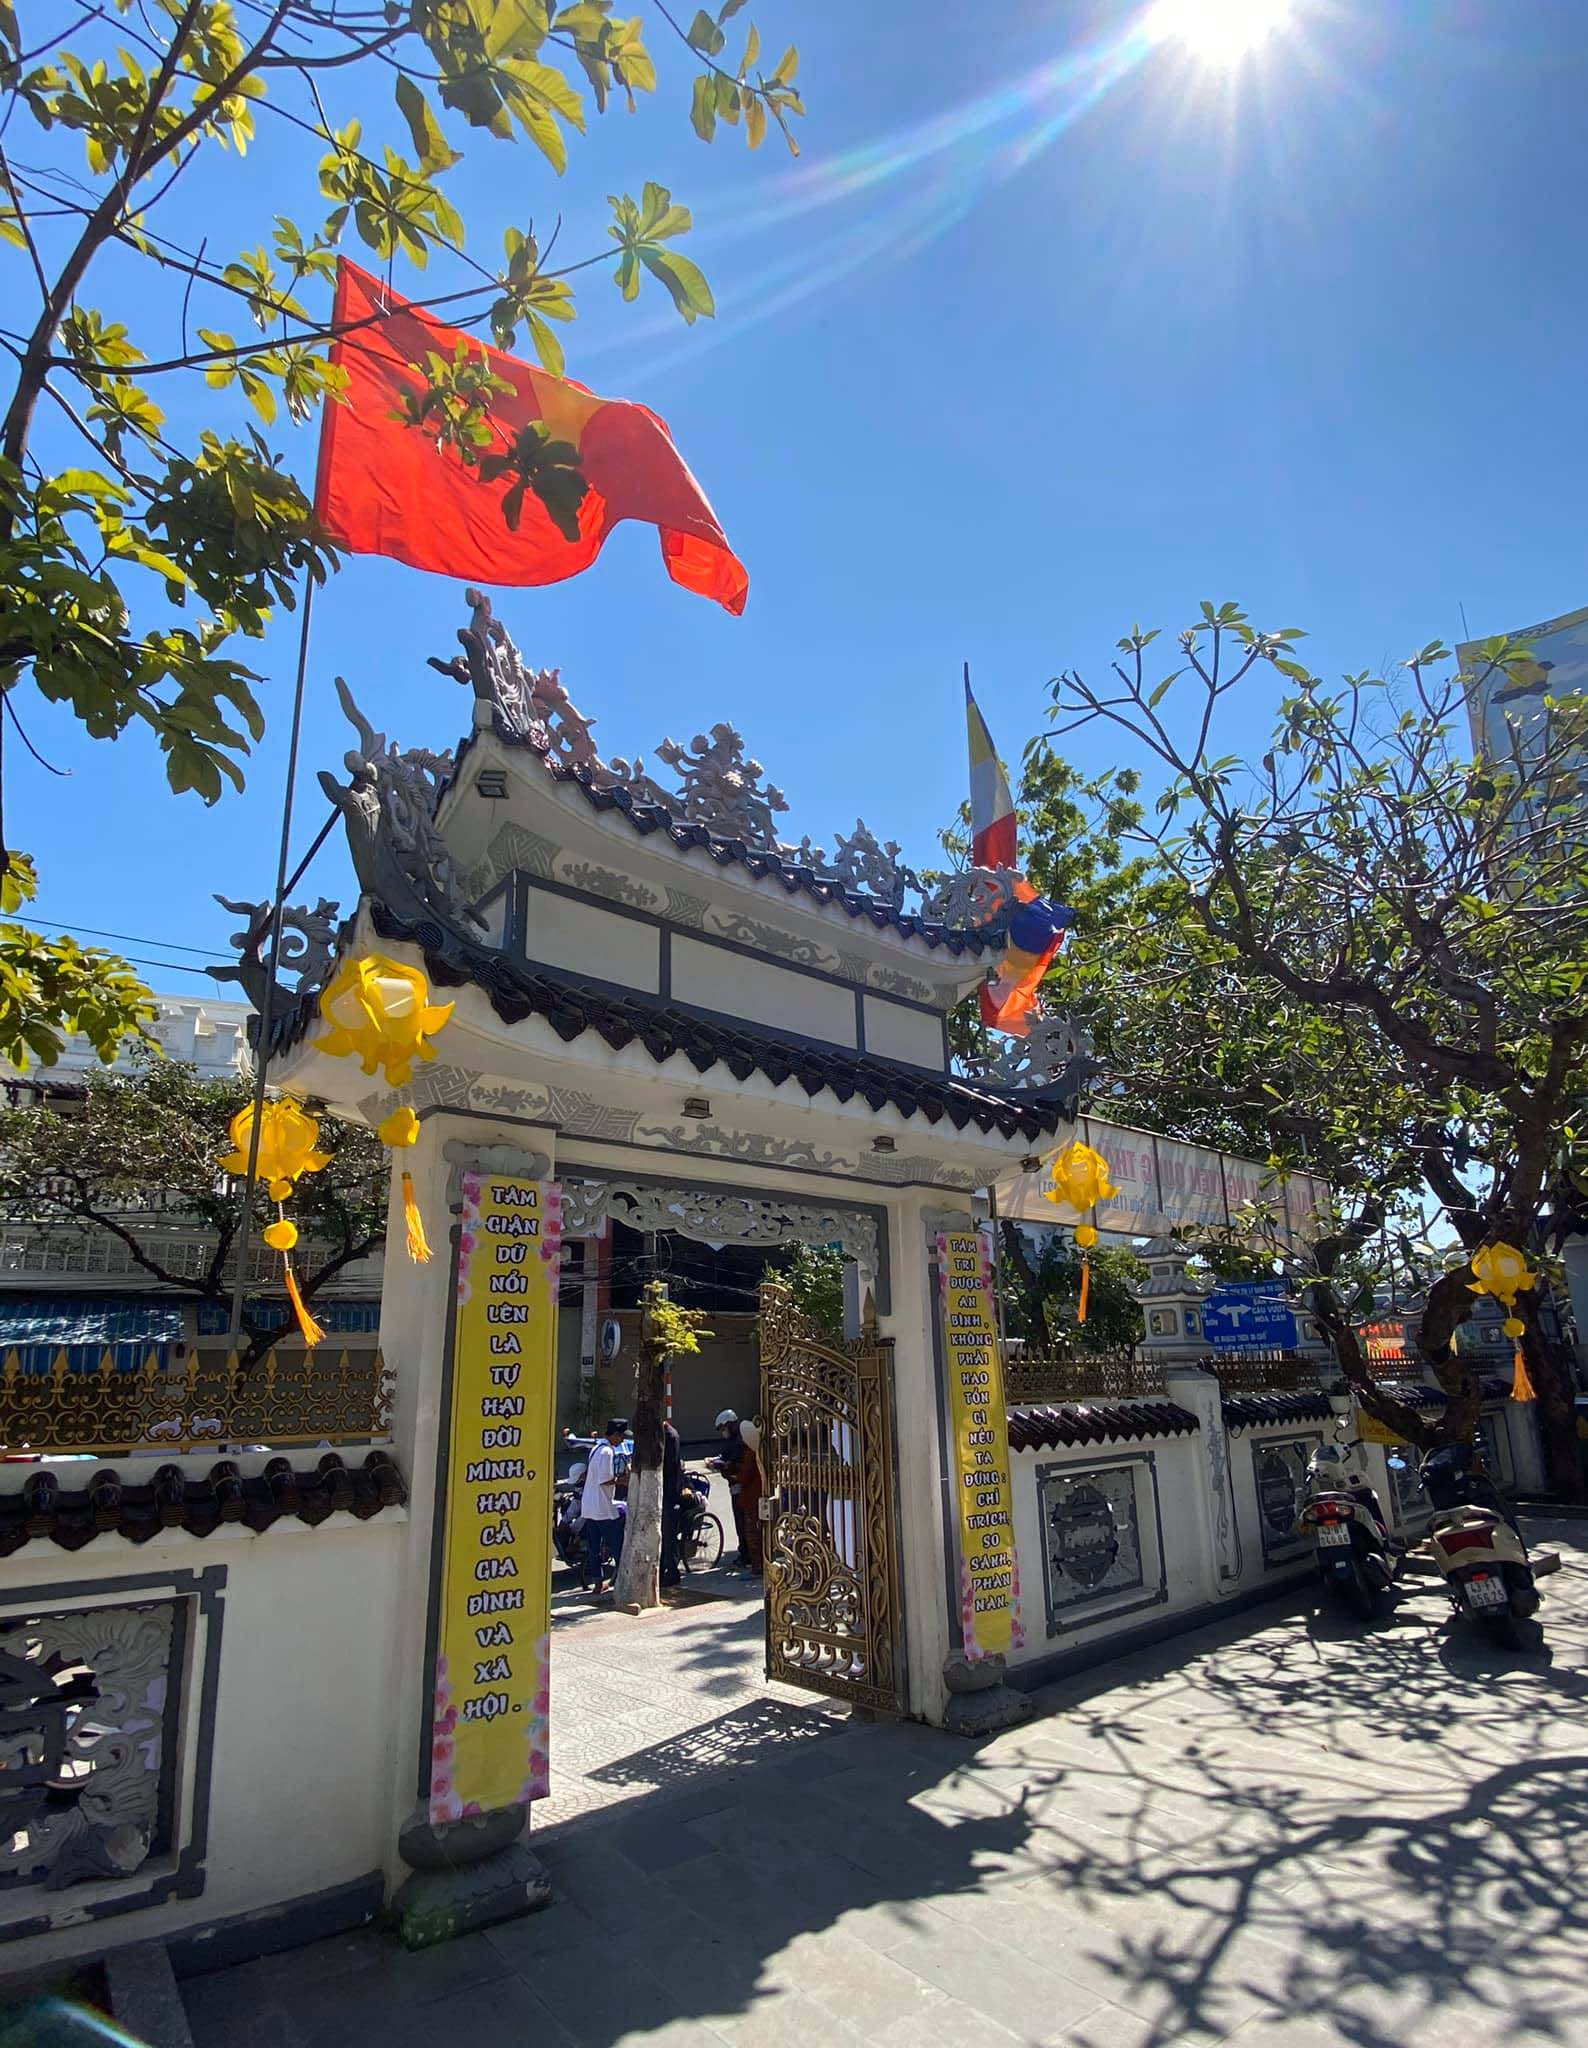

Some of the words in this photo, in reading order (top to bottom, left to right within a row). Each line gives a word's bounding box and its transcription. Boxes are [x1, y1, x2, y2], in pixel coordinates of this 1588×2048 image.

[491, 1185, 537, 1207] TÂM
[485, 1213, 539, 1238] GIẬN
[496, 1242, 527, 1263] DỮ
[951, 1238, 977, 1253] TÂM
[490, 1269, 528, 1294] NỔI
[487, 1301, 528, 1323] LÊN
[958, 1295, 977, 1308] AN
[490, 1332, 522, 1354] LÀ
[950, 1331, 993, 1346] KHÔNG
[490, 1363, 521, 1389] TỰ
[961, 1371, 989, 1385] HAO
[964, 1387, 990, 1405] TỐN
[482, 1397, 525, 1420] HẠI
[482, 1425, 521, 1448] ĐỜI
[968, 1427, 995, 1445] NẾU
[975, 1451, 994, 1465] TA
[477, 1491, 520, 1516] HẠI
[480, 1519, 515, 1546] CẢ
[982, 1534, 1000, 1549] SO
[475, 1557, 519, 1580] GIA
[972, 1573, 1011, 1592] PHÀN
[467, 1588, 524, 1616] ĐÌNH
[475, 1621, 513, 1648] VÀ
[474, 1654, 512, 1684] XÃ
